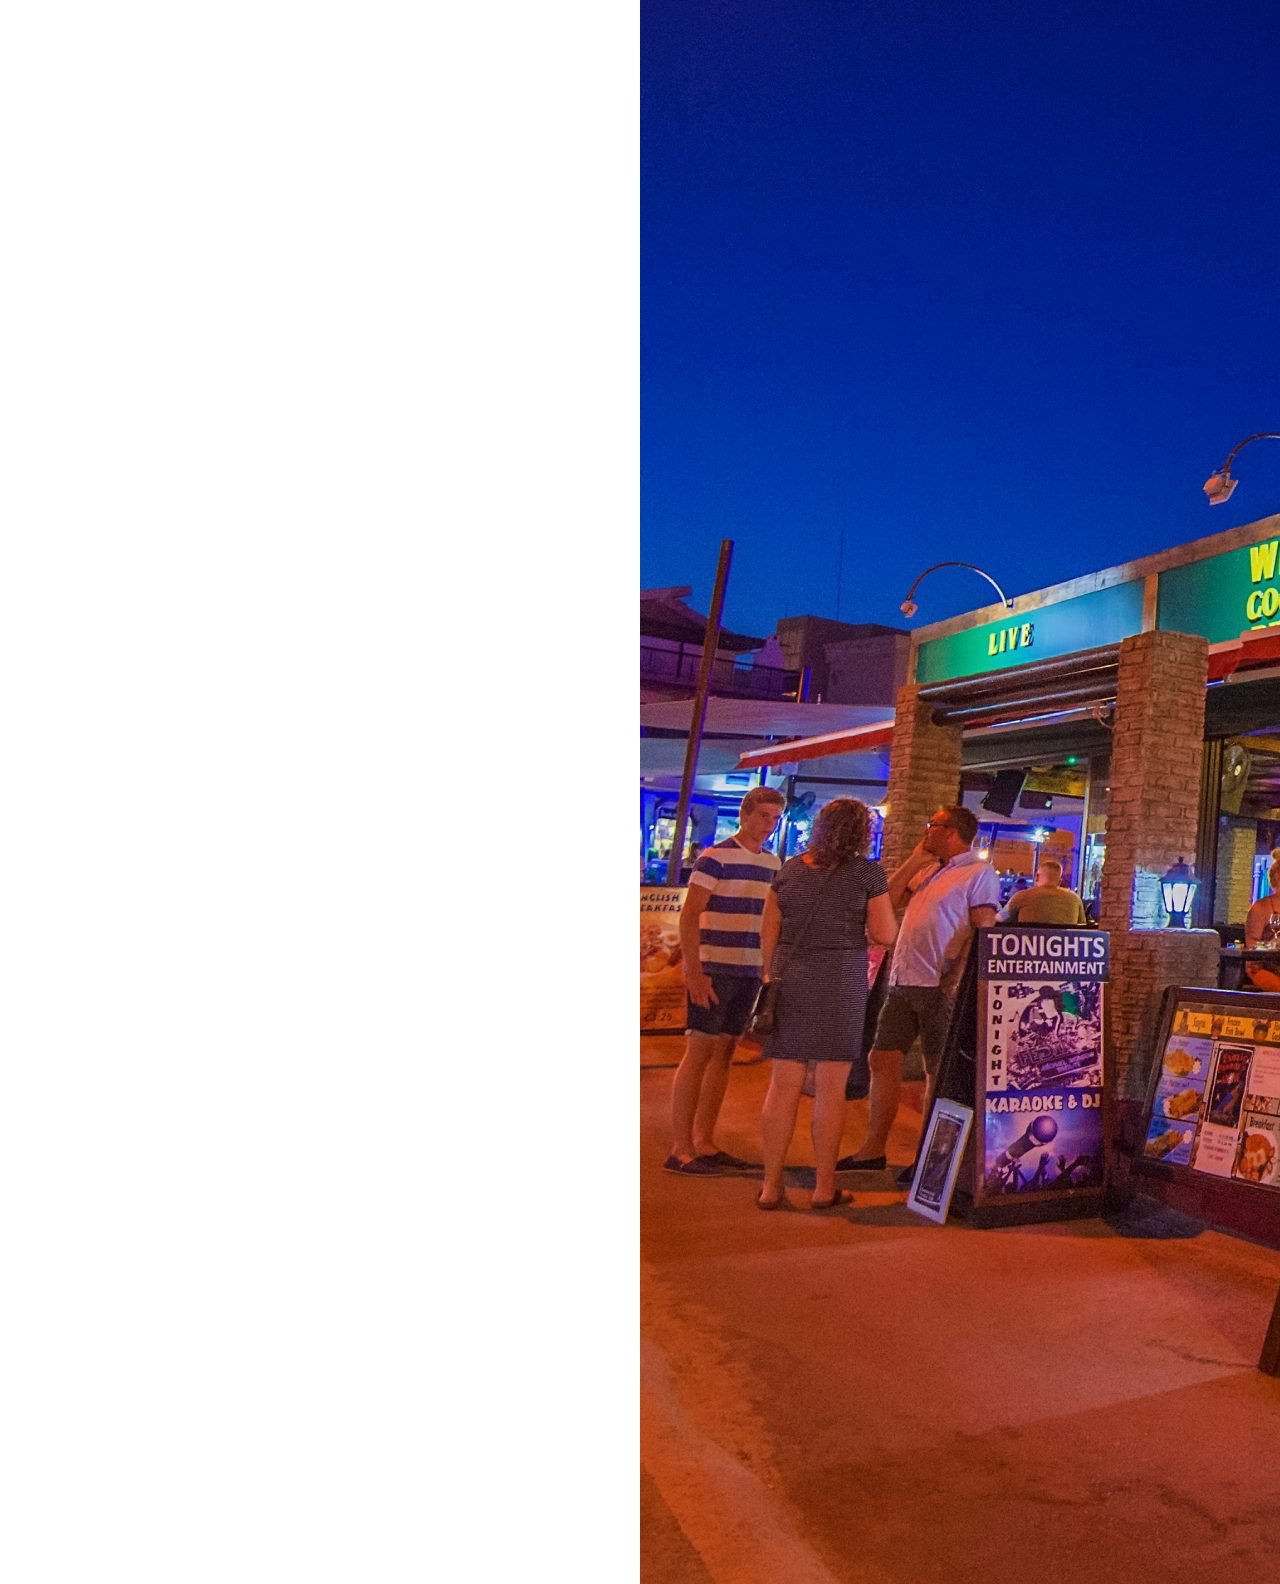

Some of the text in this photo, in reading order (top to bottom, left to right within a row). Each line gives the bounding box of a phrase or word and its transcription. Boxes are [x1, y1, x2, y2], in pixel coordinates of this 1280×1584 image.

[988, 622, 1032, 656] LIVE
[987, 933, 1105, 958] TONIGHTS
[988, 959, 1105, 976] ENTERTAINMENT
[985, 1093, 1101, 1114] KARAOKE & DJ
